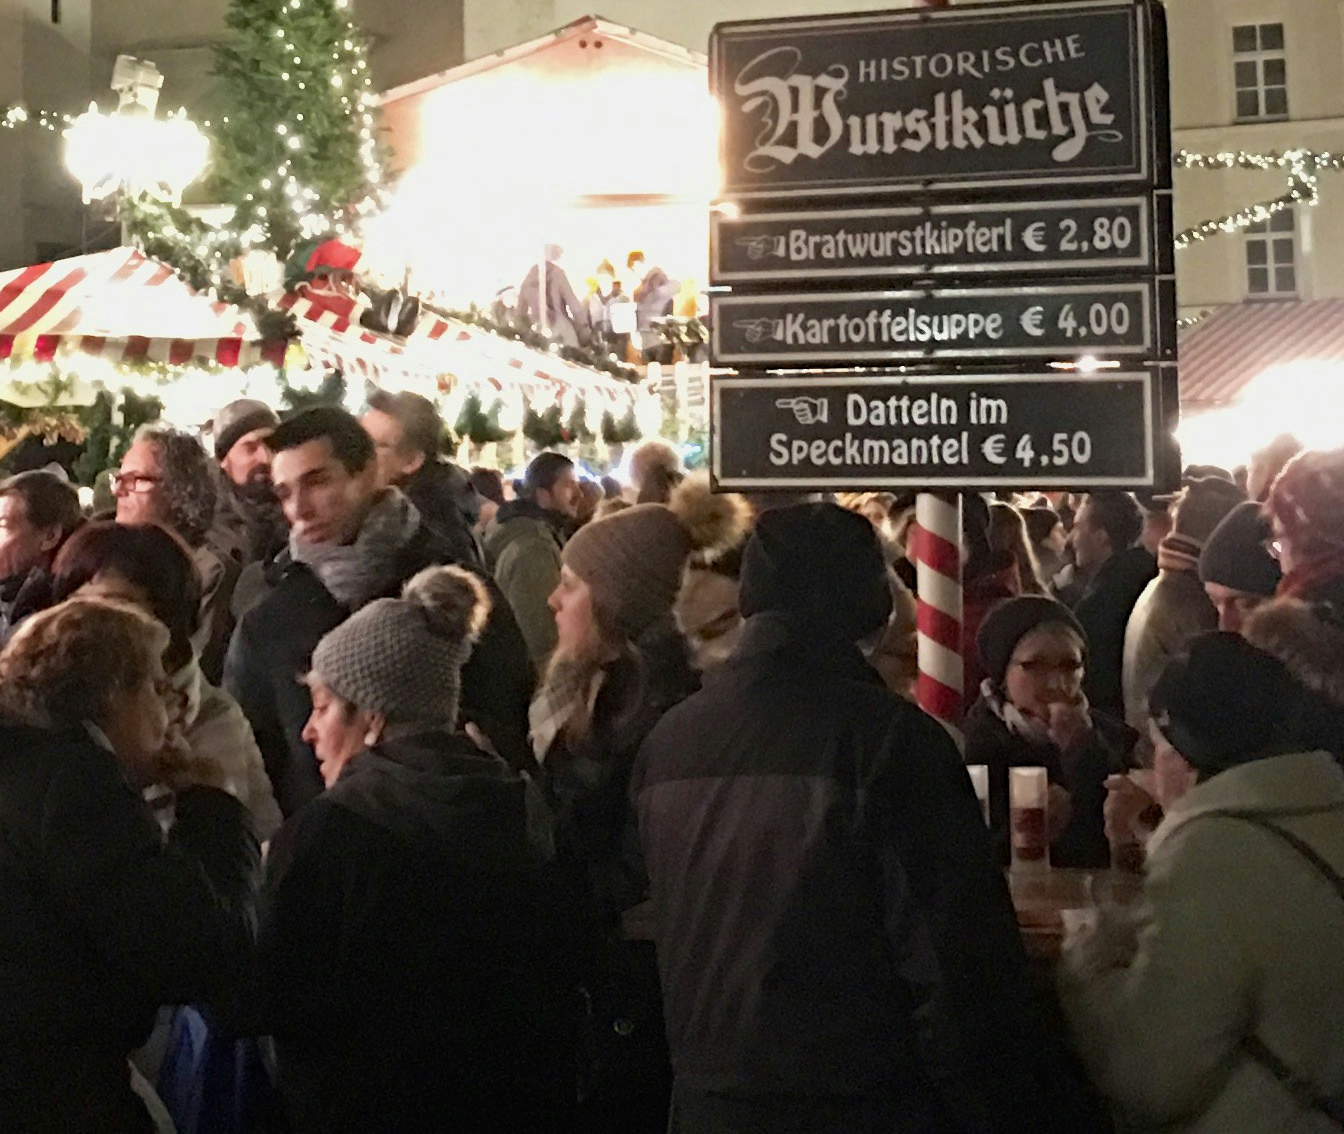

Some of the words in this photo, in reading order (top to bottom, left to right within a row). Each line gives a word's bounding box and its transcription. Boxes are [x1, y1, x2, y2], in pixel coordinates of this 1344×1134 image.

[858, 34, 1086, 83] HISTORISCHE
[734, 46, 1124, 172] Wurstküche
[789, 217, 1013, 261] Bratwurstkipferl
[1022, 221, 1048, 253] €
[1058, 216, 1133, 254] 2,80
[785, 307, 1004, 346] Kartoffelsuppe
[1019, 305, 1046, 337] €
[1057, 301, 1131, 339] 4,00
[846, 391, 957, 426] Datteln
[969, 391, 1009, 425] im
[768, 431, 970, 467] Speckmantel
[980, 433, 1008, 464] €
[1014, 430, 1092, 468] 4,50
